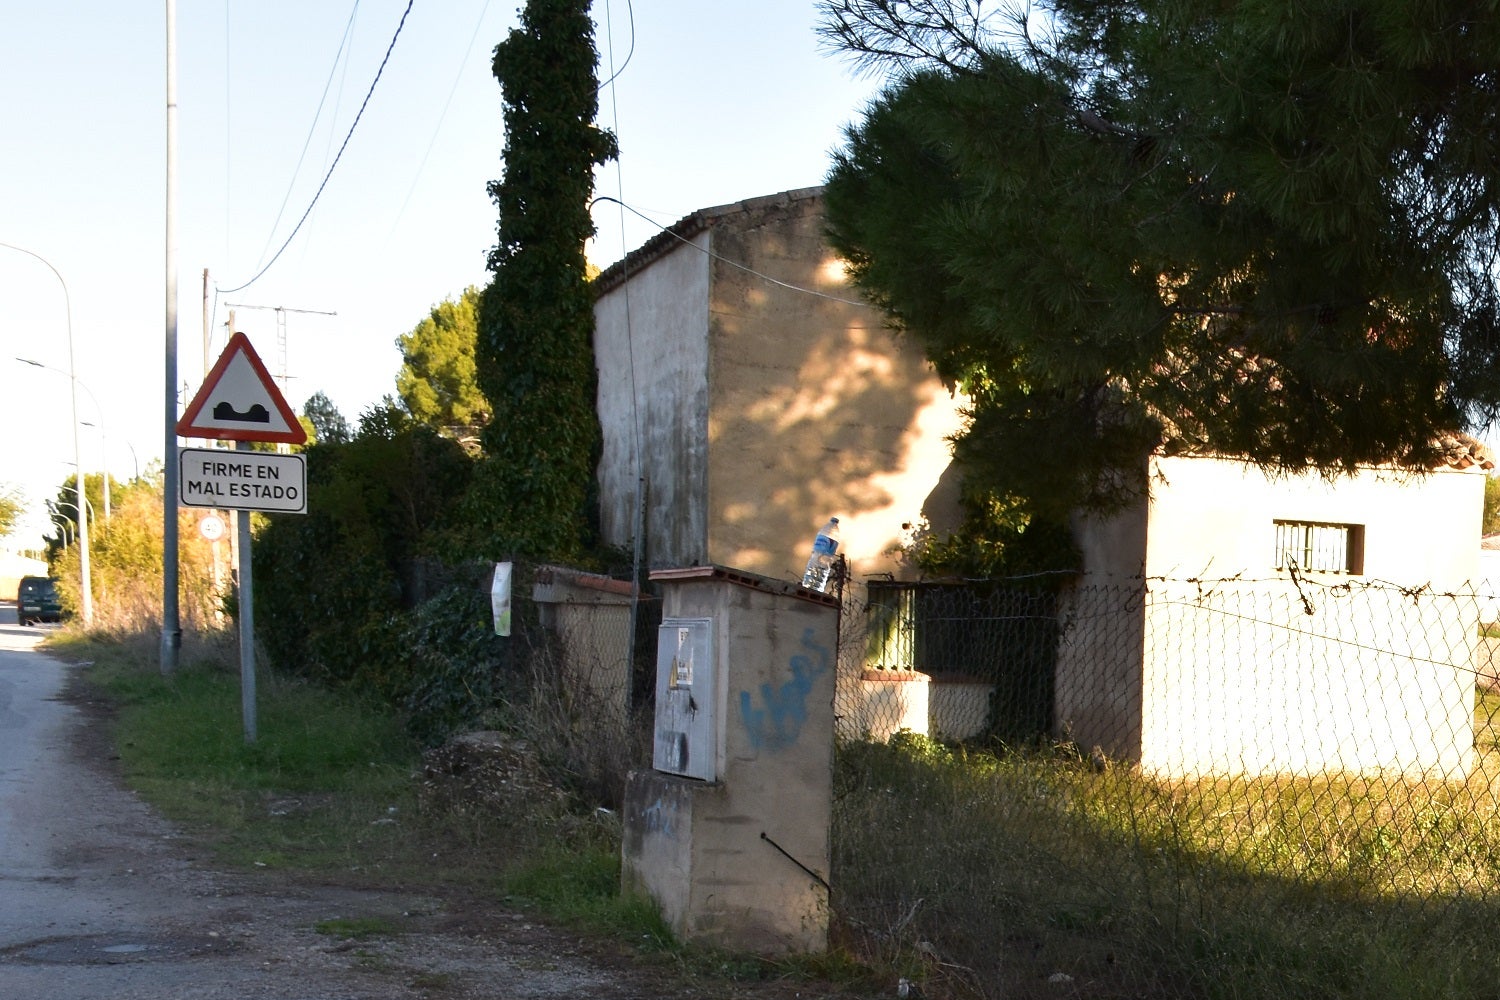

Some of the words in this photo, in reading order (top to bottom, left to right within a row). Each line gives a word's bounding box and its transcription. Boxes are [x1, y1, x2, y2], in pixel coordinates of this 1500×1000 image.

[202, 462, 252, 478] FIRME
[257, 465, 279, 480] EN
[188, 480, 225, 496] MAL
[229, 483, 298, 500] ESTADO
